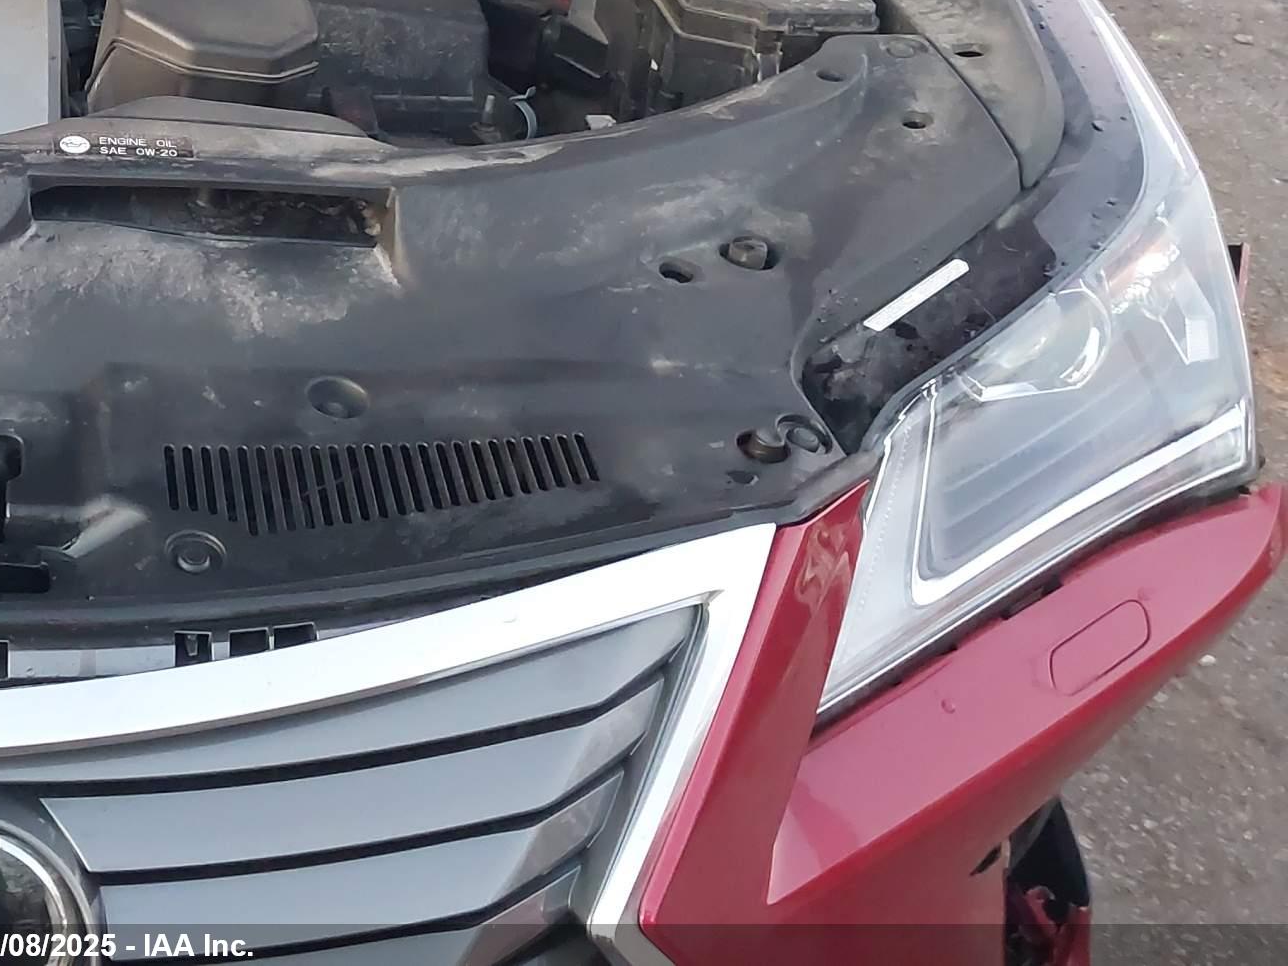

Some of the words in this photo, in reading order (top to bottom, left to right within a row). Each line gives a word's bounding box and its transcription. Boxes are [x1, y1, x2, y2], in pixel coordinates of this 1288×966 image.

[99, 136, 147, 146] ENGINE
[156, 140, 177, 148] OIL
[99, 146, 127, 155] SAE
[135, 148, 178, 157] 0W-20
